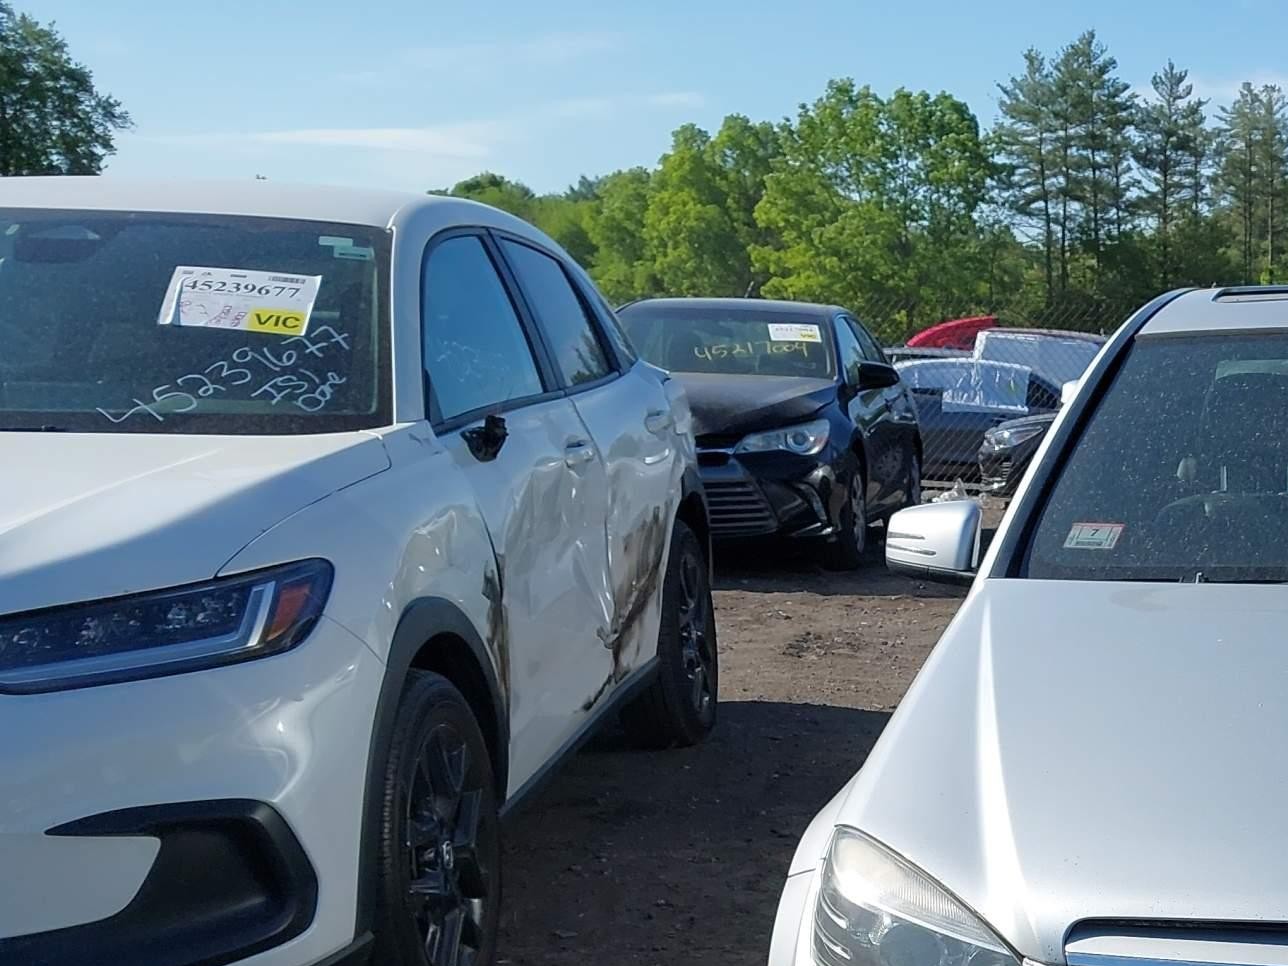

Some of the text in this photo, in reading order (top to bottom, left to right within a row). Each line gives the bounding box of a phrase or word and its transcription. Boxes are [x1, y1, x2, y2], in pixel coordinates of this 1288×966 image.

[184, 279, 301, 298] 45239677
[255, 313, 300, 329] VIC
[96, 326, 350, 423] 45239677
[1090, 528, 1099, 537] 7
